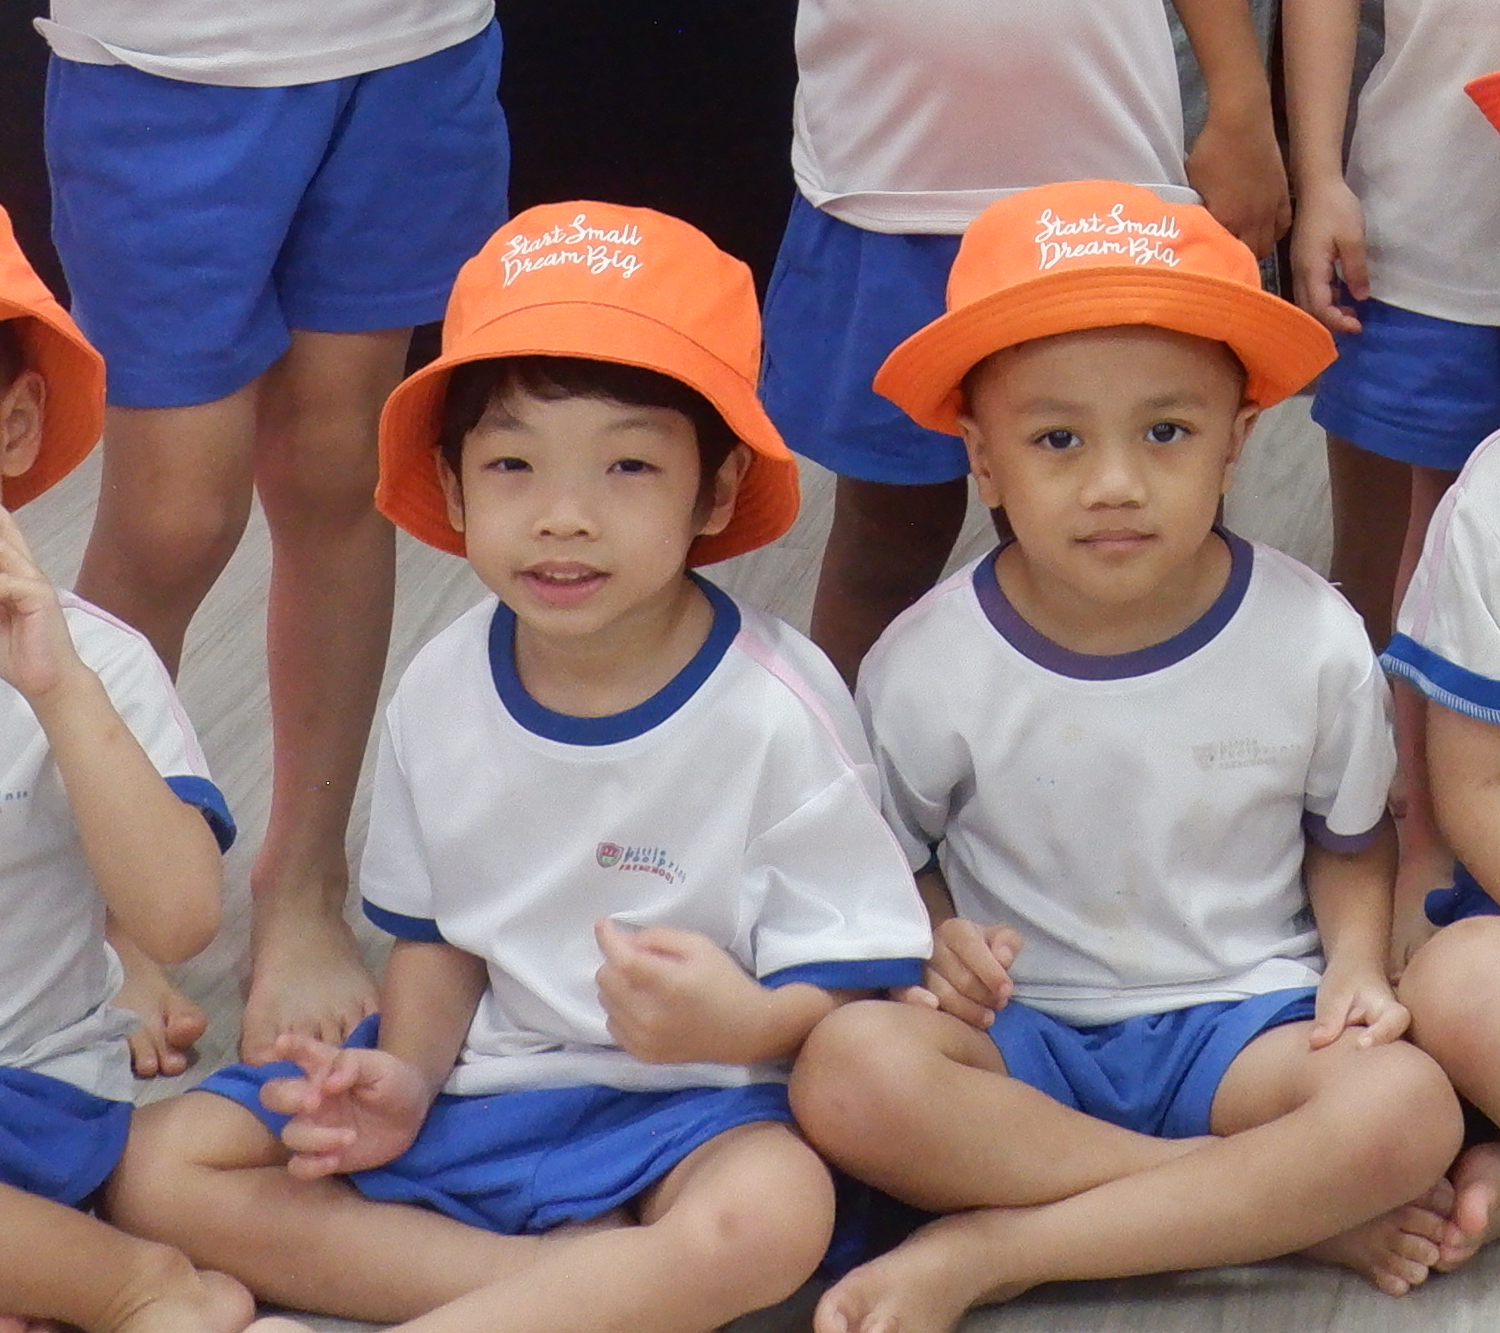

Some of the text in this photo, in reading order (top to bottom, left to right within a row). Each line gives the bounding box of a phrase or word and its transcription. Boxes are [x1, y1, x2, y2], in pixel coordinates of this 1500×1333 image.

[504, 213, 642, 260] Start Small
[1035, 202, 1180, 243] Start Small
[503, 243, 643, 289] Dream Big
[1038, 237, 1181, 272] Dream Big
